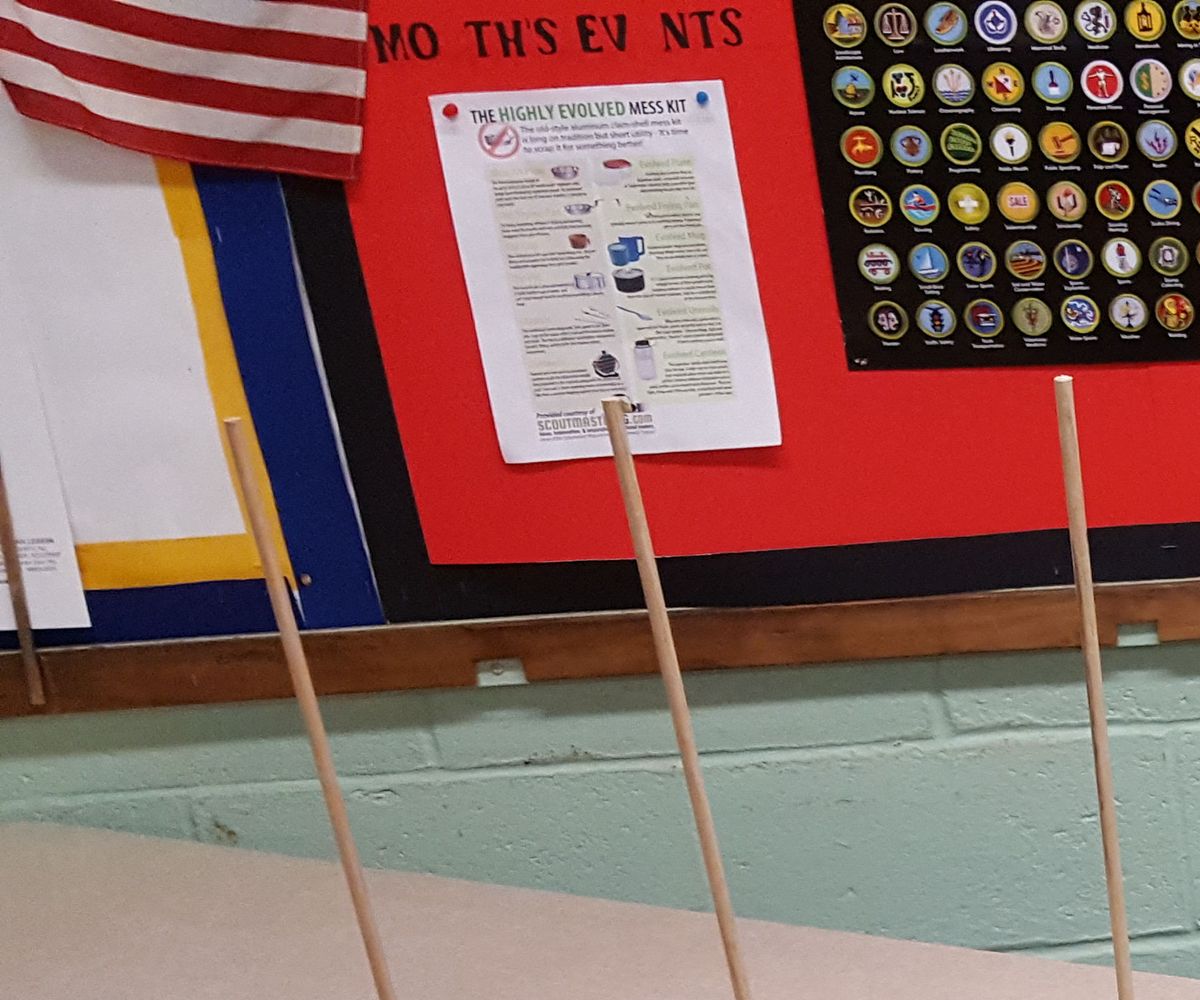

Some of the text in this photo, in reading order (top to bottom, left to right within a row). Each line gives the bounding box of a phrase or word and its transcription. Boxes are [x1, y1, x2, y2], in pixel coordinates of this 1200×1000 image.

[576, 13, 627, 53] EV
[660, 8, 743, 50] NTS
[470, 99, 687, 124] THE HIGHLY EVOLVED MESS KIT
